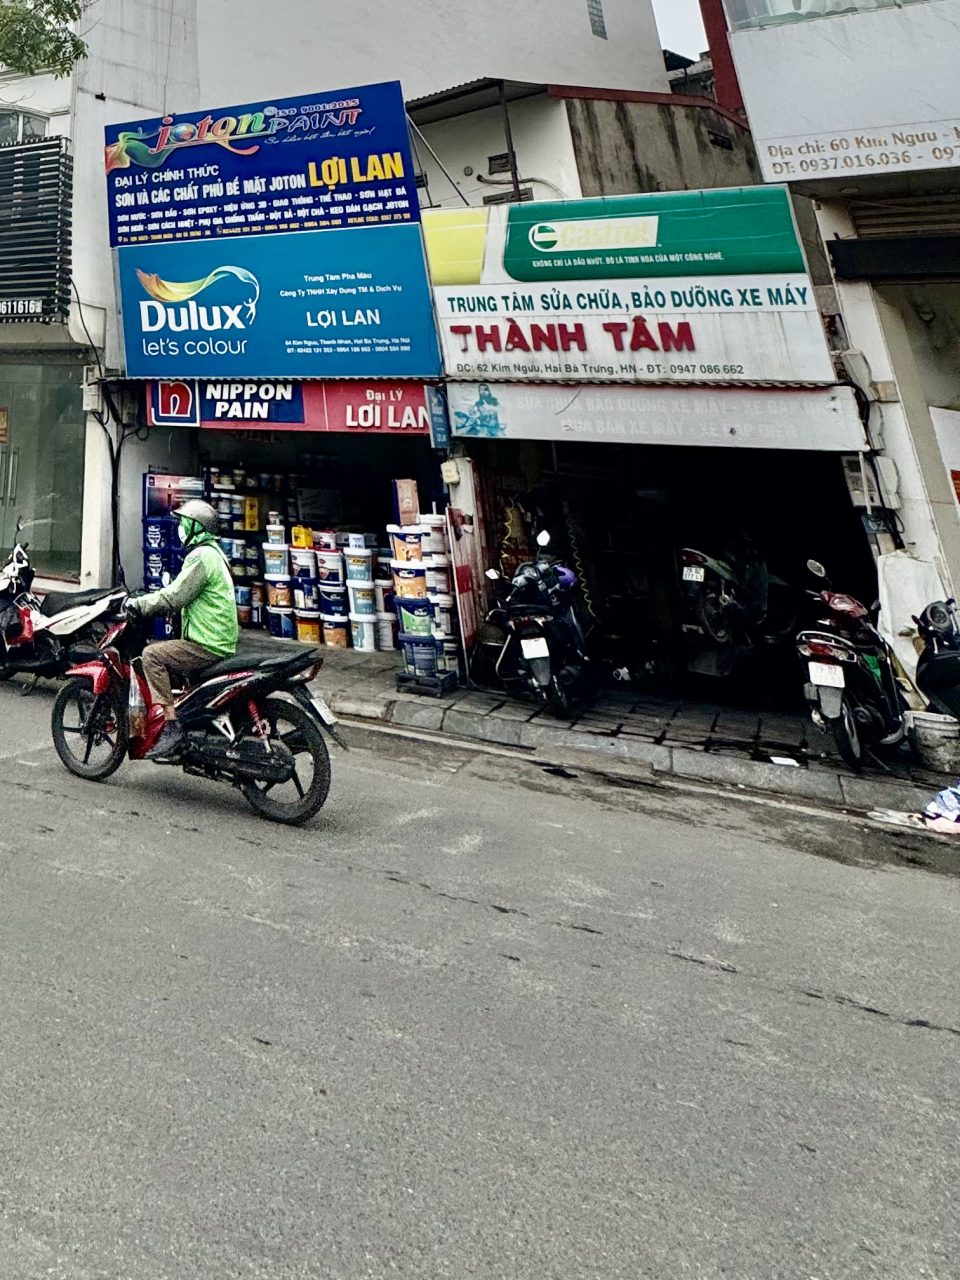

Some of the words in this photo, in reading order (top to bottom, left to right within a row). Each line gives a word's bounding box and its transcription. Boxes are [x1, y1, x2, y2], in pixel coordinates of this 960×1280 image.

[268, 108, 363, 134] PAINT
[767, 146, 793, 159] Địa
[830, 138, 849, 151] 60
[892, 131, 937, 147] Ngưu
[772, 161, 795, 175] ĐT:
[799, 150, 912, 172] 0937.016.036
[932, 146, 960, 160] 09
[115, 177, 132, 188] ĐẠI
[135, 172, 148, 185] LÝ
[152, 169, 184, 183] CHÍNH
[187, 164, 219, 179] THỨC
[115, 193, 135, 207] SƠN
[151, 187, 171, 203] CÁC
[173, 181, 199, 201] CHẤT
[203, 178, 224, 198] PHỦ
[243, 176, 267, 195] MẶT
[269, 174, 306, 191] JOTON
[308, 156, 348, 190] LỢI
[350, 152, 405, 182] LAN
[333, 193, 352, 201] THAO
[359, 190, 375, 199] SƠN
[385, 200, 409, 210] JOTON
[304, 275, 324, 283] Trung
[342, 272, 355, 280] Pha
[448, 296, 497, 312] TRUNG
[502, 291, 534, 311] TÂM
[541, 288, 573, 311] SỬA
[631, 286, 666, 308] BẢO
[671, 286, 734, 308] DƯỠNG
[737, 288, 763, 306] XE
[767, 283, 807, 305] MÁY
[139, 300, 246, 332] Dulux
[306, 310, 337, 328] LỢI
[341, 309, 381, 326] LAN
[450, 318, 588, 352] THÀNH
[602, 315, 696, 352] TÂM
[184, 337, 248, 354] colour
[477, 363, 489, 372] 62
[491, 363, 511, 372] Kim
[545, 363, 562, 373] Hai
[565, 363, 580, 373] Bà
[620, 365, 637, 373] HN
[647, 364, 666, 374] ĐT:
[670, 364, 696, 374] 0947
[699, 364, 720, 374] 086
[723, 364, 745, 374] 662
[205, 384, 292, 400] NIPPON
[390, 388, 403, 401] LÝ
[215, 402, 269, 419] PAIN
